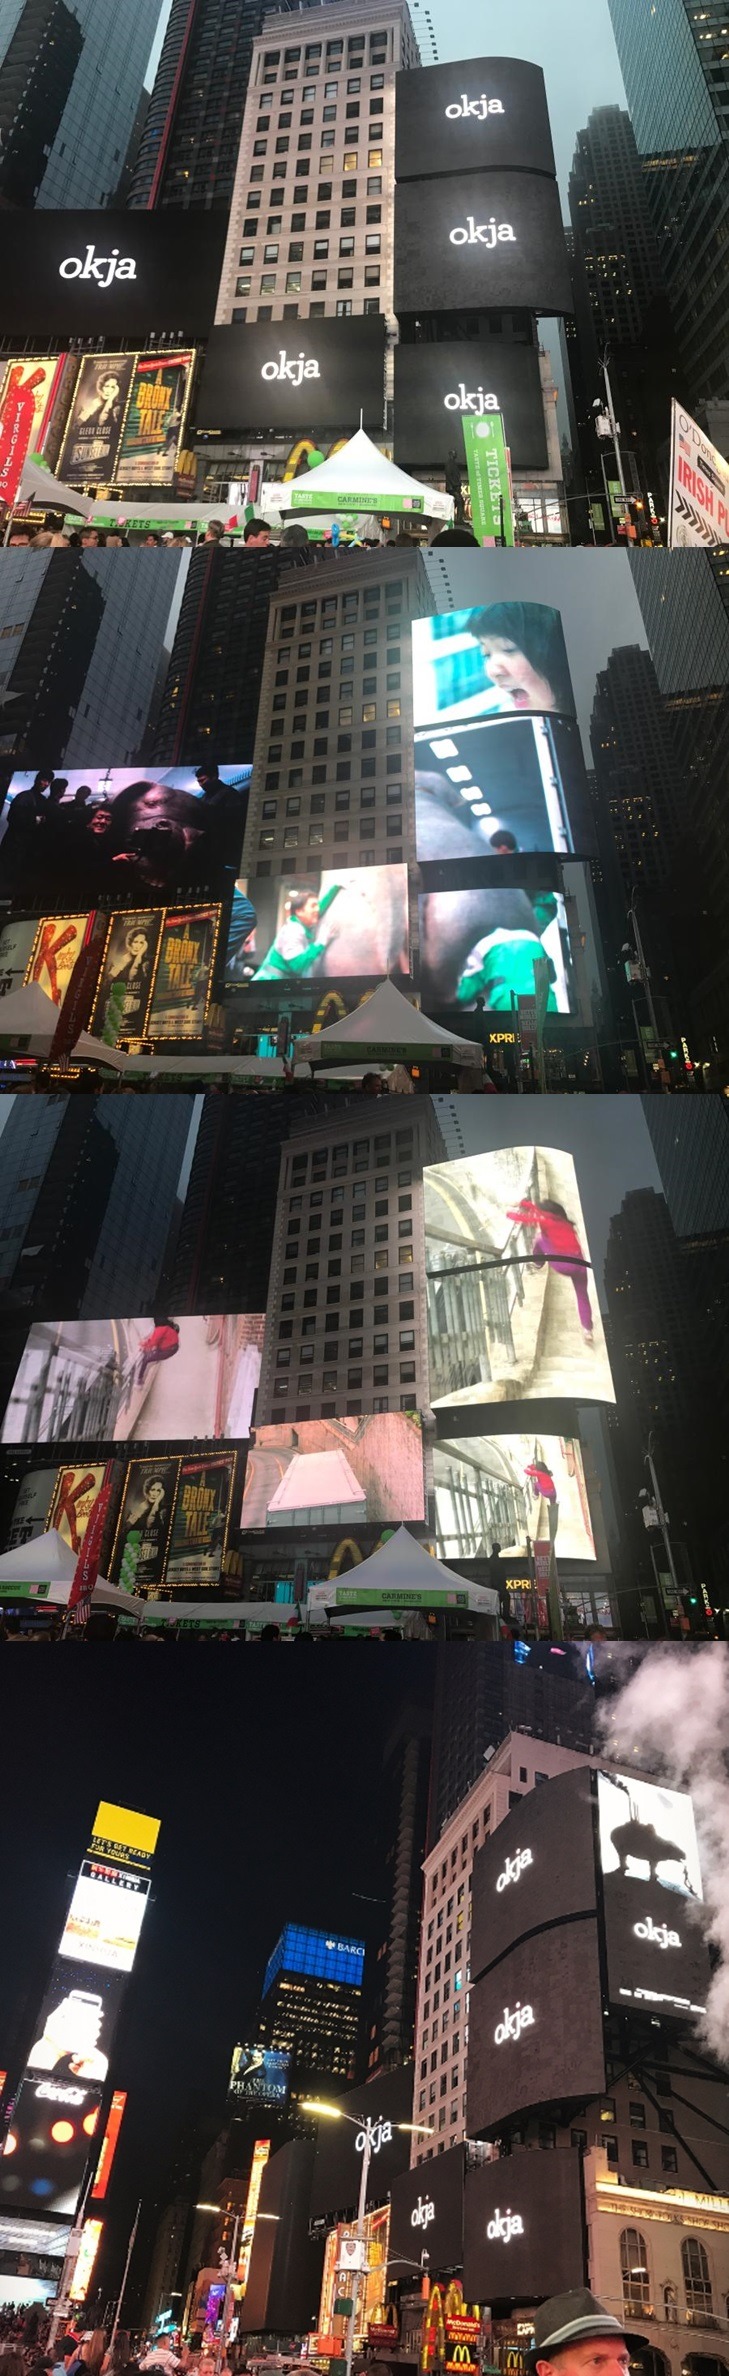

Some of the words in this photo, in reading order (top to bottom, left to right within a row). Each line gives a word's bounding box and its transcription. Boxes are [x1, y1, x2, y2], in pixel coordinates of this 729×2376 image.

[446, 94, 505, 120] okja
[450, 217, 517, 249] okja
[60, 246, 136, 287] okja
[262, 351, 320, 386] okja
[136, 382, 172, 409] BRONX
[444, 384, 500, 416] okja
[138, 408, 166, 435] TALE
[677, 455, 714, 517] IRISH
[165, 937, 200, 964] BRONX
[182, 1485, 216, 1511] BRONX
[185, 1510, 211, 1537] TALE
[382, 1592, 422, 1601] CARMINE'S
[107, 1848, 130, 1860] YOURS
[114, 1843, 127, 1852] GET
[128, 1848, 151, 1859] READY
[90, 1872, 139, 1891] GALLERY
[497, 1849, 533, 1892] okja
[634, 1917, 682, 1949] okja
[495, 2002, 535, 2044] okja
[230, 2080, 286, 2094] PHANTOM
[355, 2115, 392, 2154] okja
[412, 2195, 434, 2229] okja
[487, 2209, 524, 2243] okja
[446, 2318, 480, 2329] McDonald's
